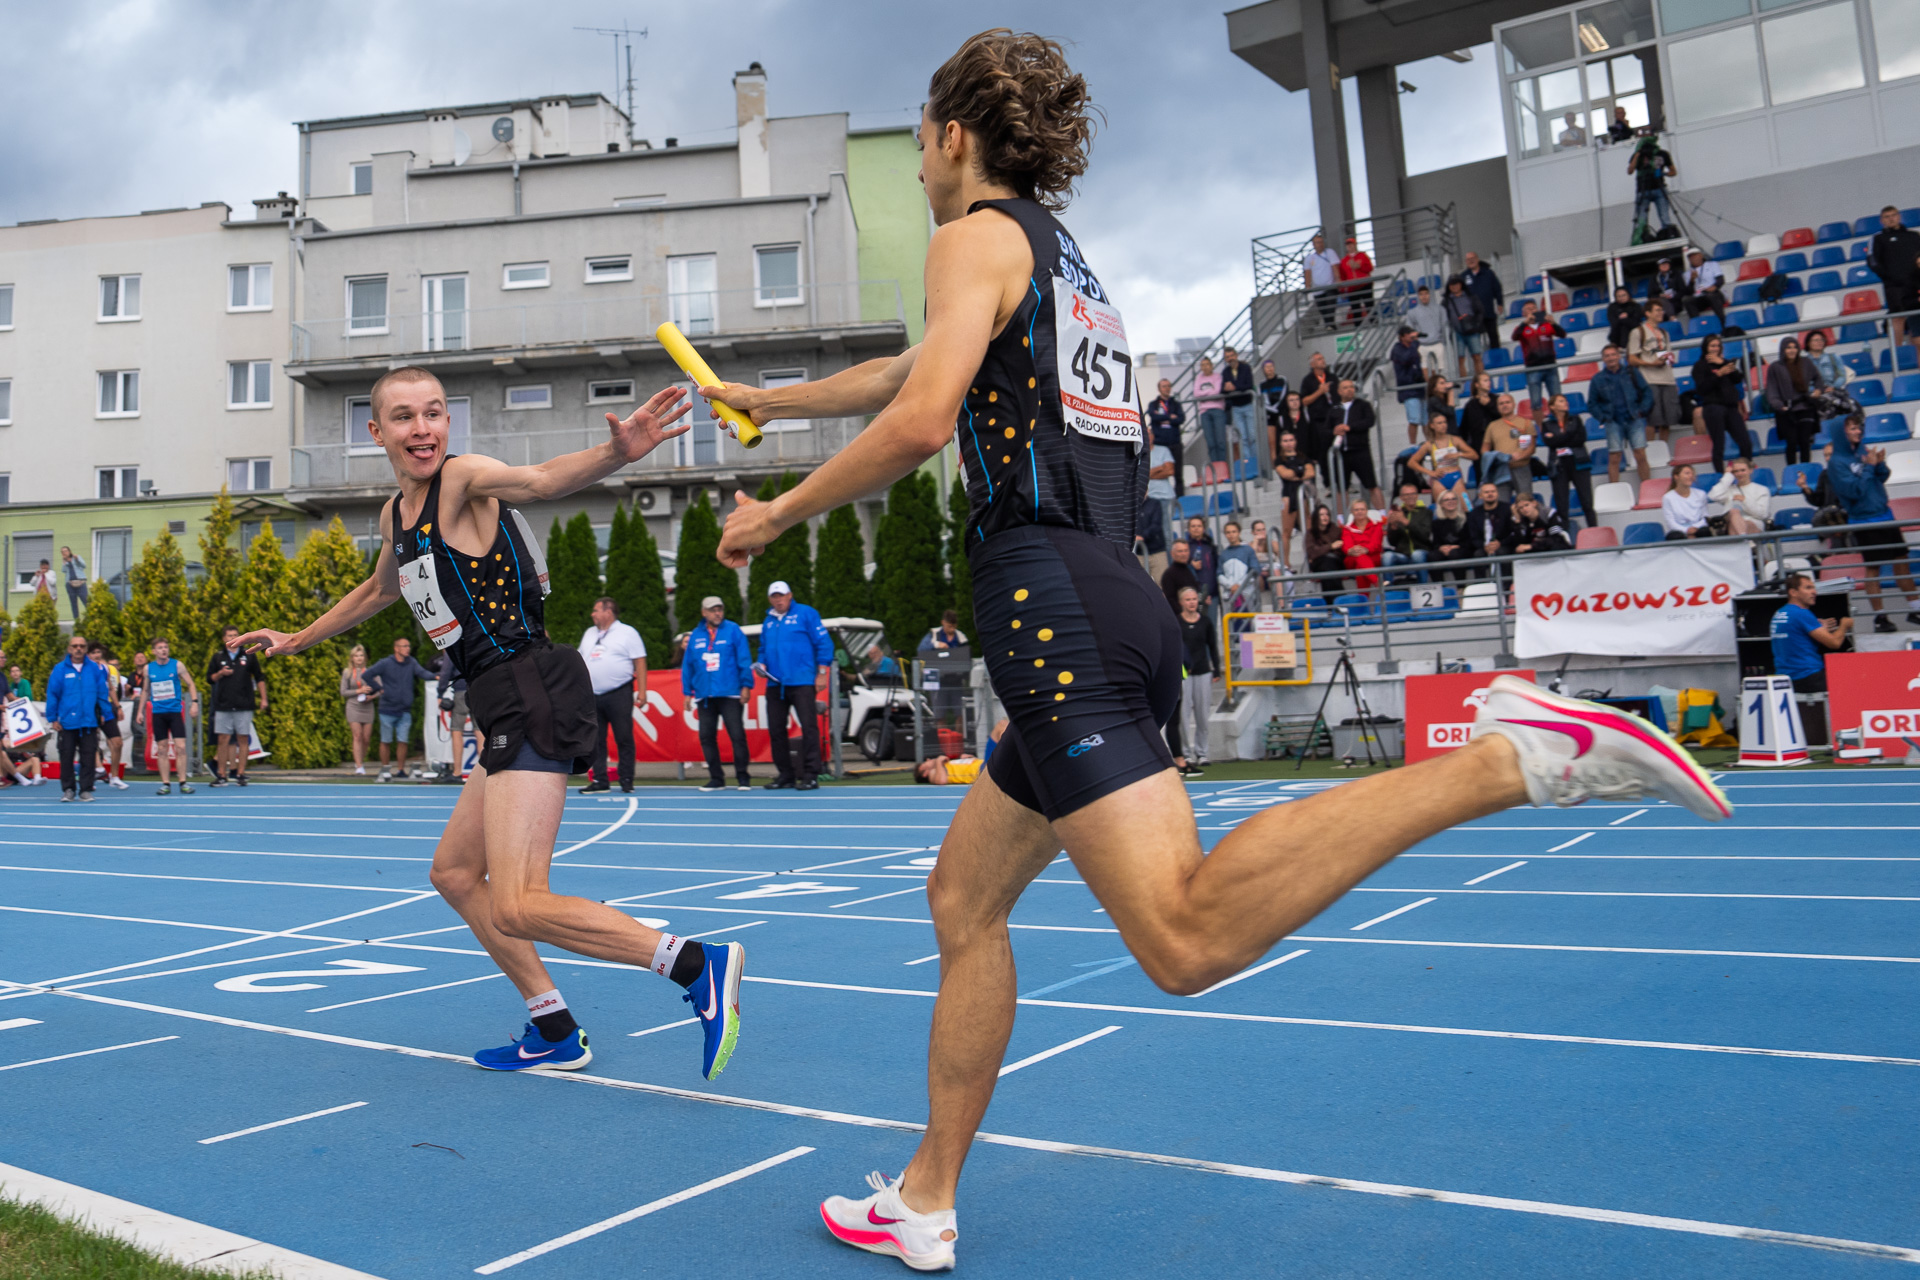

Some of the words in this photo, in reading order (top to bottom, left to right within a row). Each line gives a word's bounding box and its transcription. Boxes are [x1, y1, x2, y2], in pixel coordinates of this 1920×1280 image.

[1071, 336, 1132, 403] 457
[1075, 416, 1111, 435] RADOM
[1113, 425, 1142, 437] 2024
[1422, 591, 1434, 607] 2
[12, 707, 33, 734] 3
[1748, 693, 1765, 745] 1
[1779, 692, 1797, 744] 1
[463, 738, 478, 770] 2
[213, 958, 428, 993] 2
